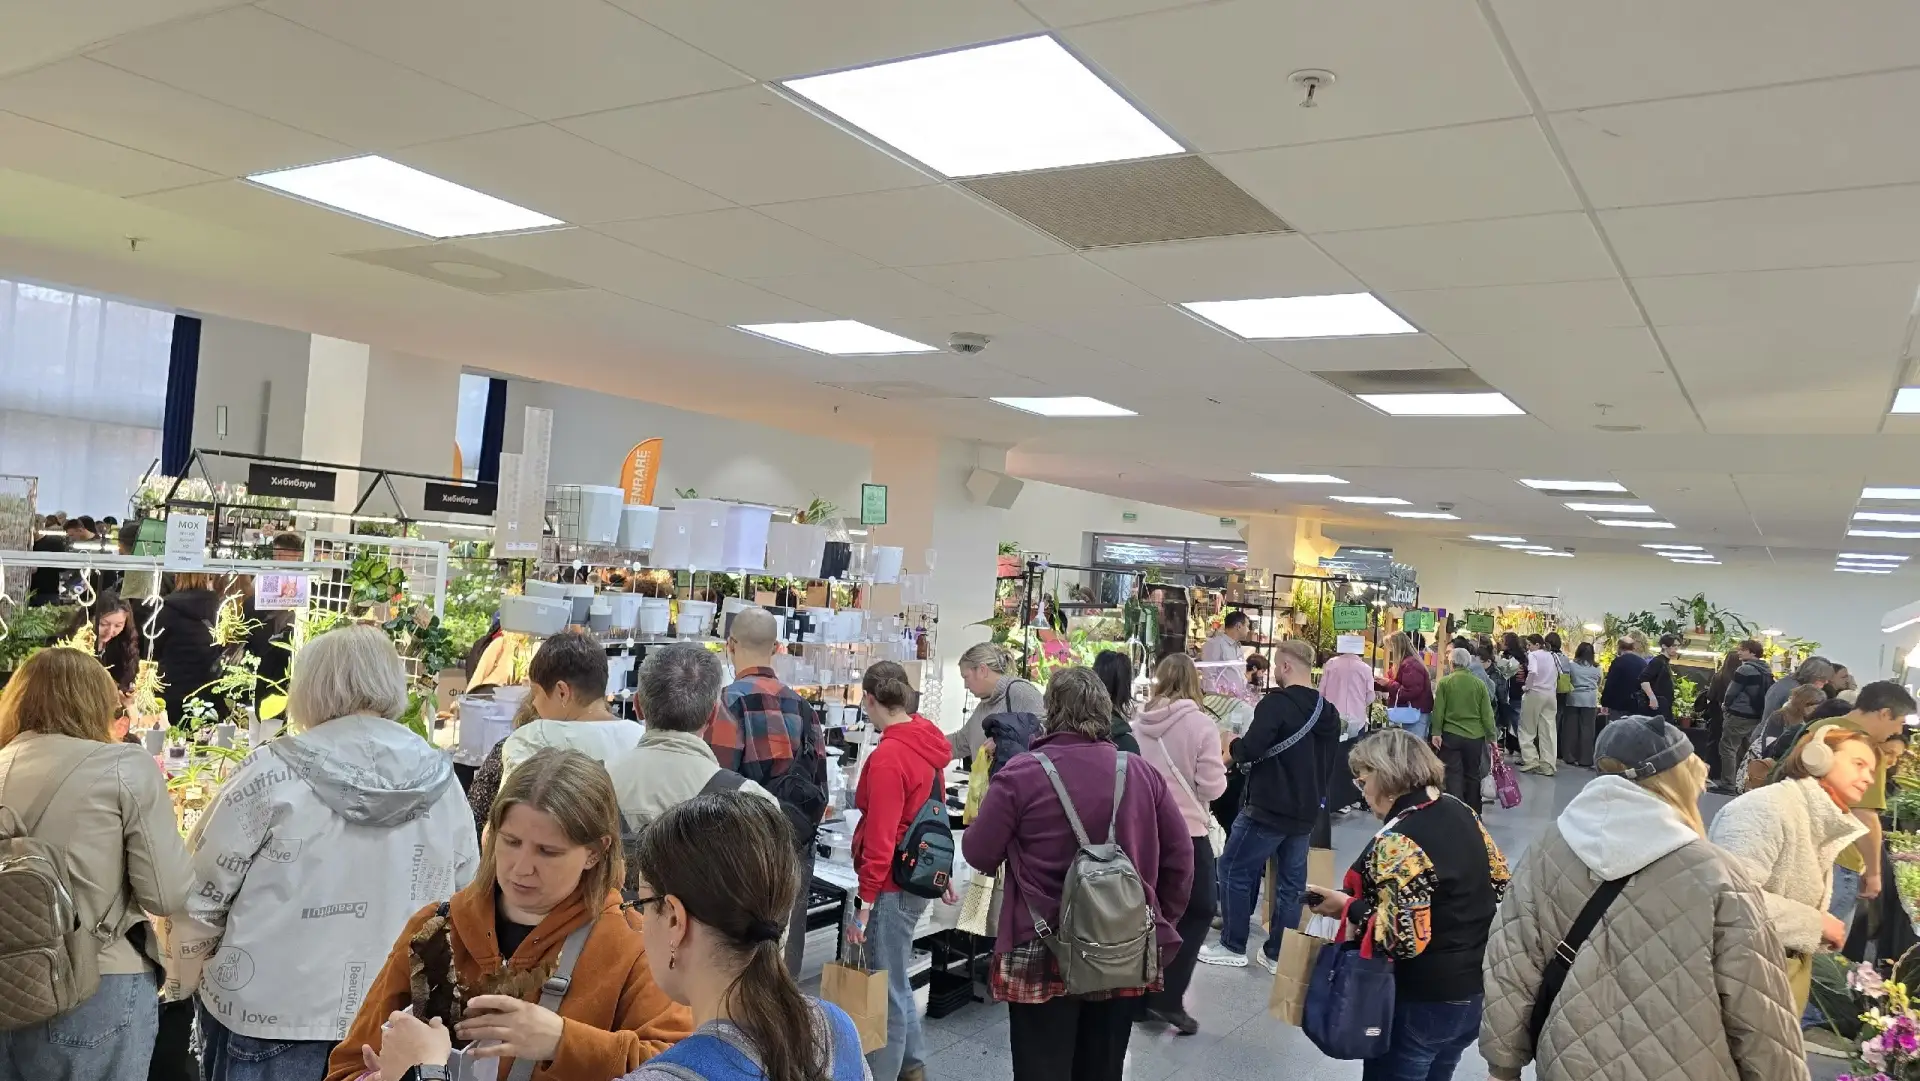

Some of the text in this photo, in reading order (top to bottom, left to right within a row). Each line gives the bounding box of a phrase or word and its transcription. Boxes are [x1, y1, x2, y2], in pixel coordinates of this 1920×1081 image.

[271, 477, 316, 490] Хибиблум
[442, 494, 479, 506] Хибиблум
[178, 521, 200, 530] МОХ
[338, 966, 361, 1038] Beautiful love
[242, 1009, 278, 1024] love
